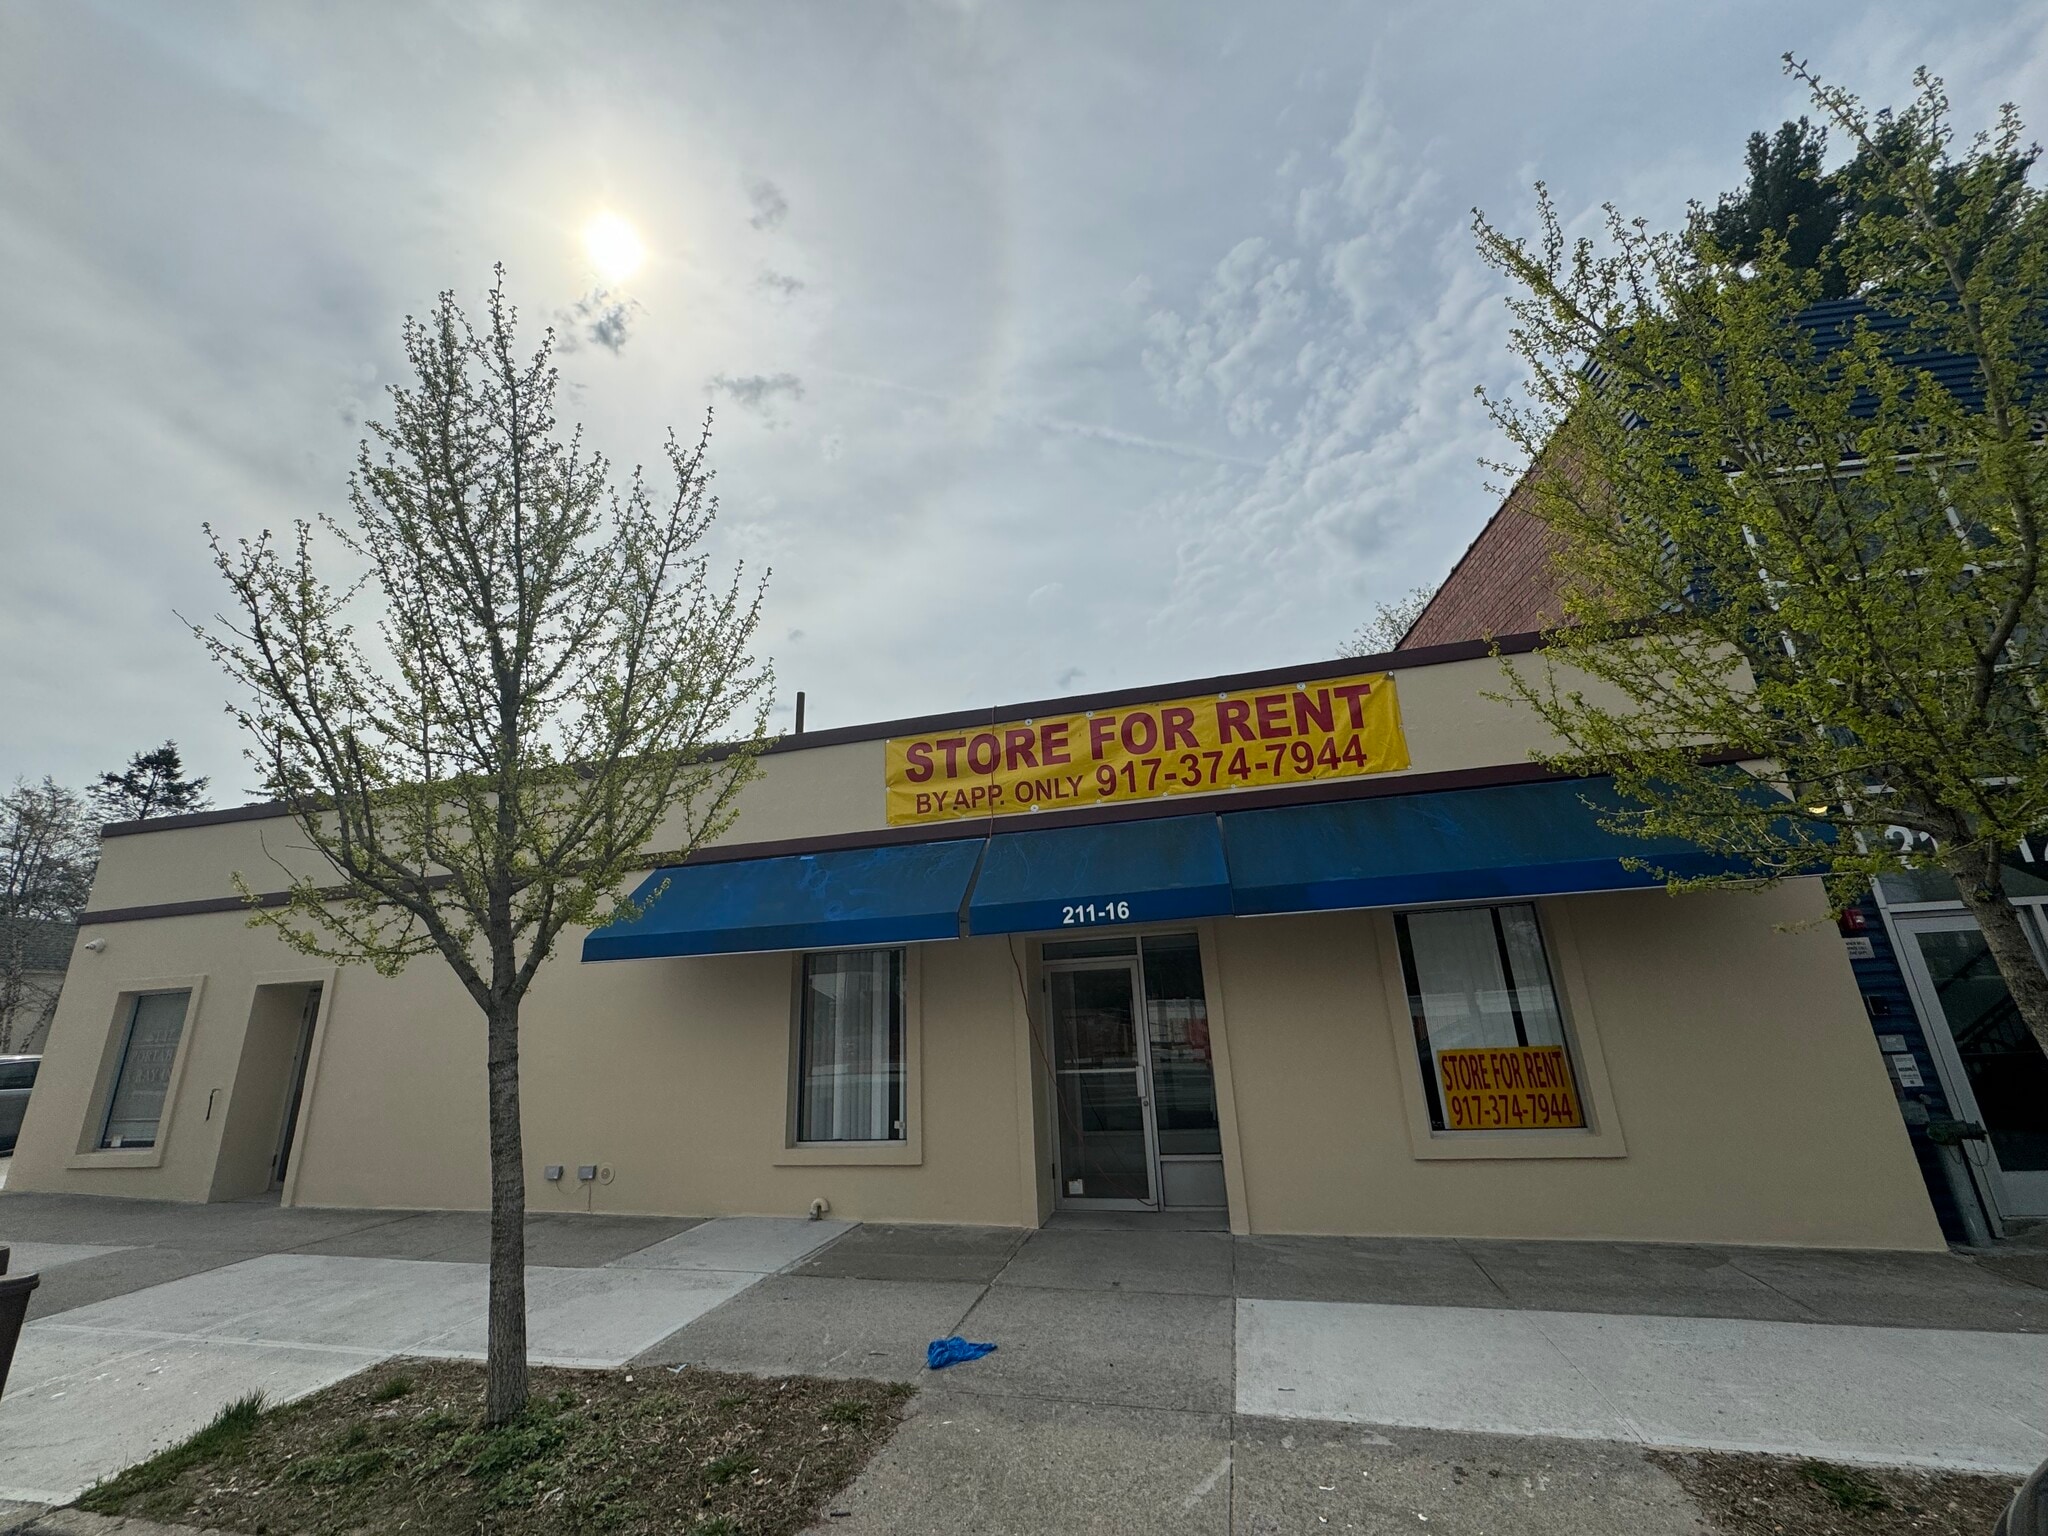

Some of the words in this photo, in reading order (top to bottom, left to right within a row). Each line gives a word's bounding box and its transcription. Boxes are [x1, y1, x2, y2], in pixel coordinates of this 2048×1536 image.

[906, 722, 1072, 783] STORE
[1089, 706, 1201, 761] FOR
[1215, 683, 1372, 745] RENT
[916, 790, 948, 815] BY
[1014, 775, 1084, 803] ONLY
[1095, 733, 1370, 797] 917-374-7944
[1061, 900, 1130, 924] 211-16
[1440, 1053, 1492, 1092] STORE
[1489, 1052, 1525, 1090] FOR
[1522, 1051, 1566, 1089] RENT
[1451, 1092, 1575, 1126] 917-374-7944
